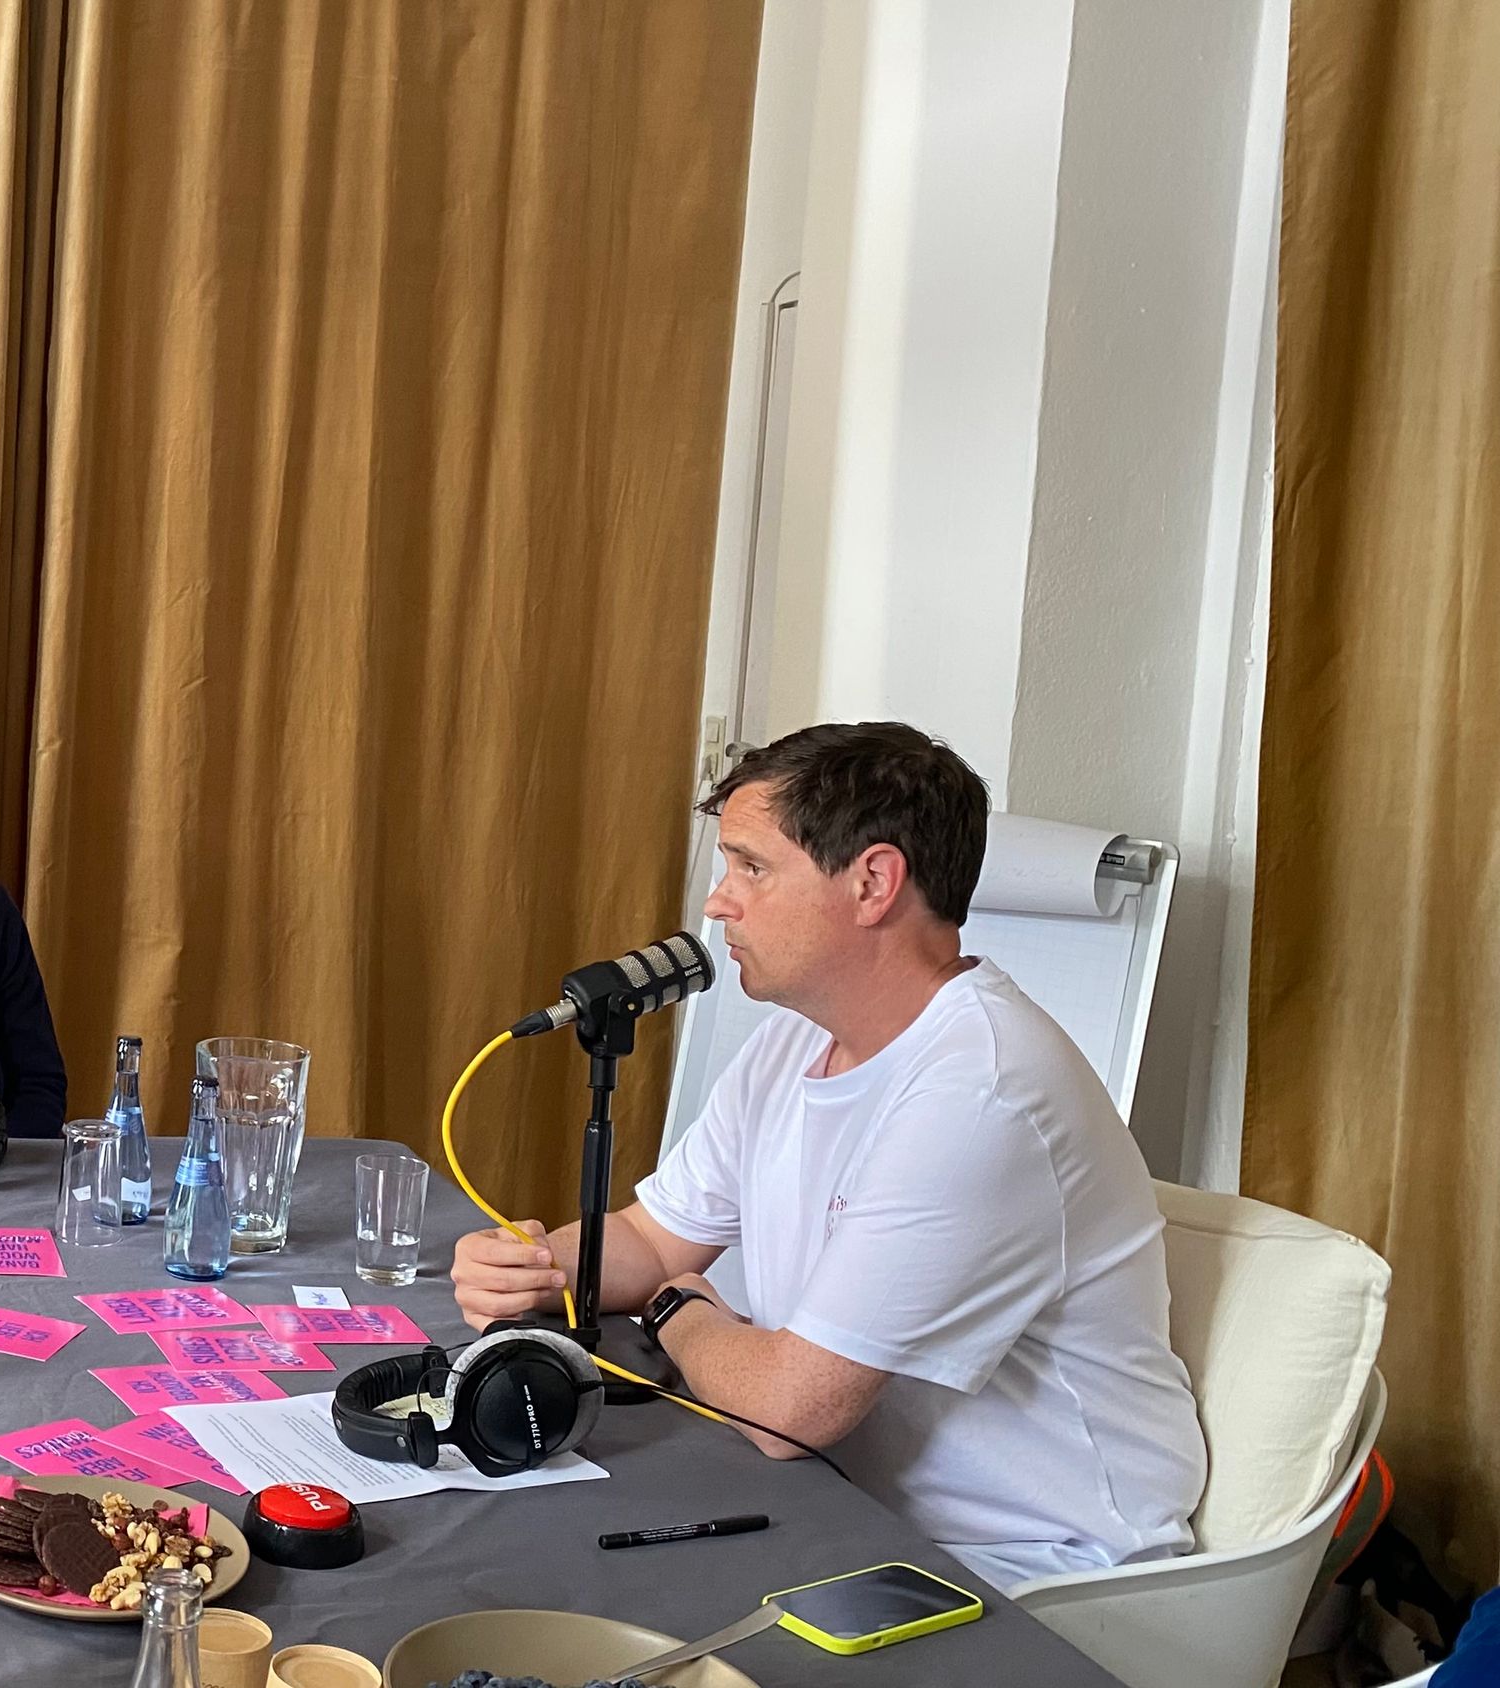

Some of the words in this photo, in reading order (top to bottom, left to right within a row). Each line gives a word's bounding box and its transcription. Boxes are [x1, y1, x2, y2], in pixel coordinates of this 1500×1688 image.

[526, 1404, 536, 1421] PRO
[531, 1423, 541, 1438] 770
[534, 1439, 542, 1449] DT
[73, 1457, 126, 1476] ABER
